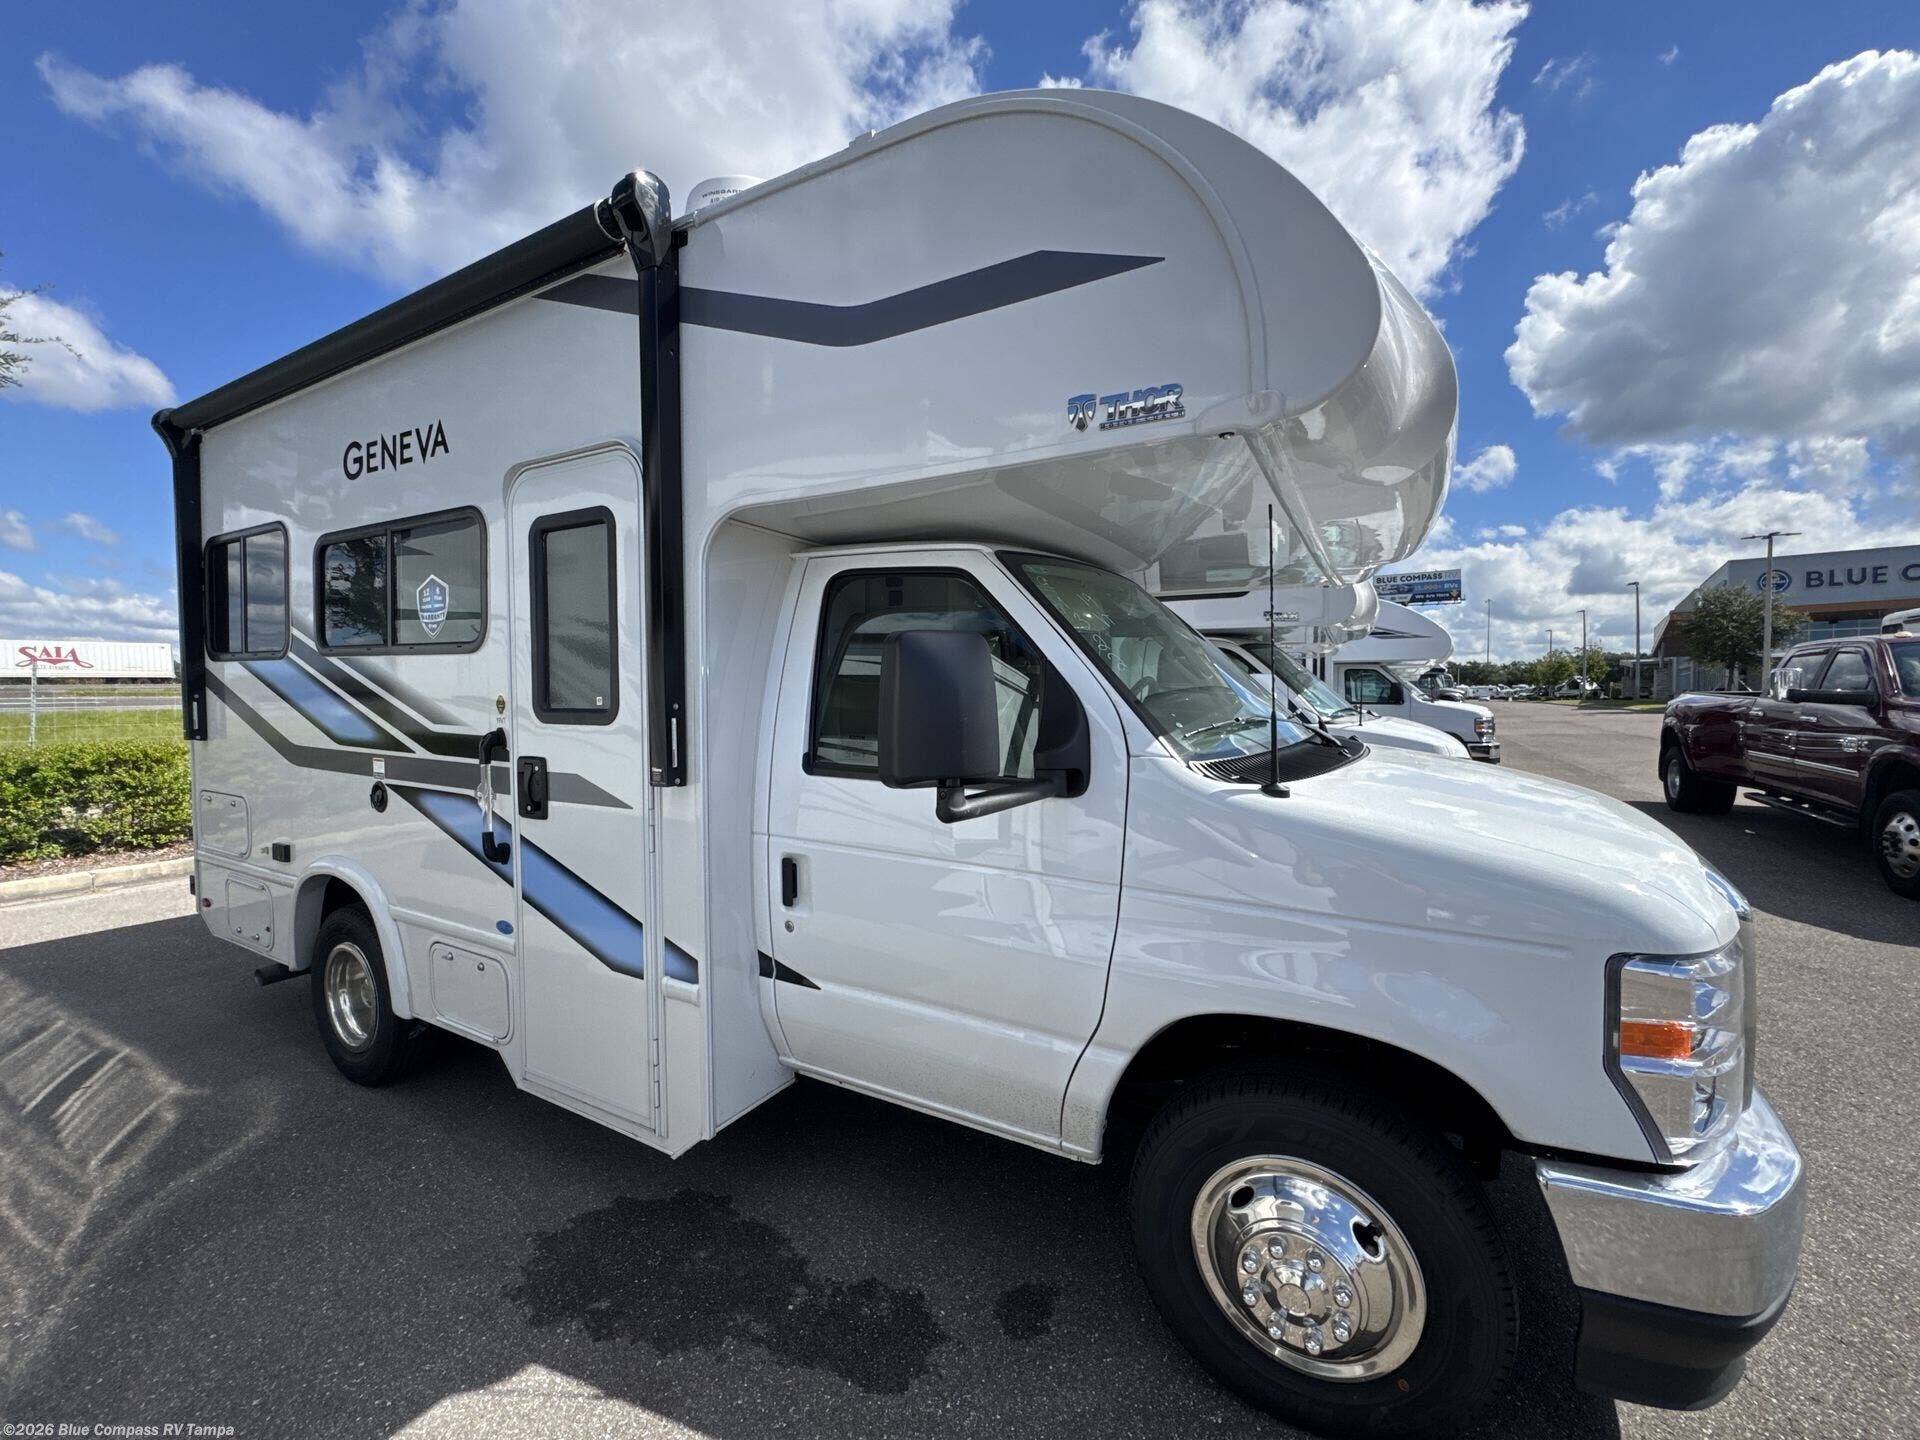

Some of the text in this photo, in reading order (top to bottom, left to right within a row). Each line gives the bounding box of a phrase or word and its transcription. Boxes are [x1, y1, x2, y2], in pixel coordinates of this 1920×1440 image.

[1100, 383, 1184, 421] THOR
[343, 419, 449, 480] GENEVA
[1376, 576, 1398, 584] BLUE
[1400, 572, 1442, 582] COMPASS
[1806, 566, 1888, 588] BLUE
[15, 646, 94, 668] SAIA
